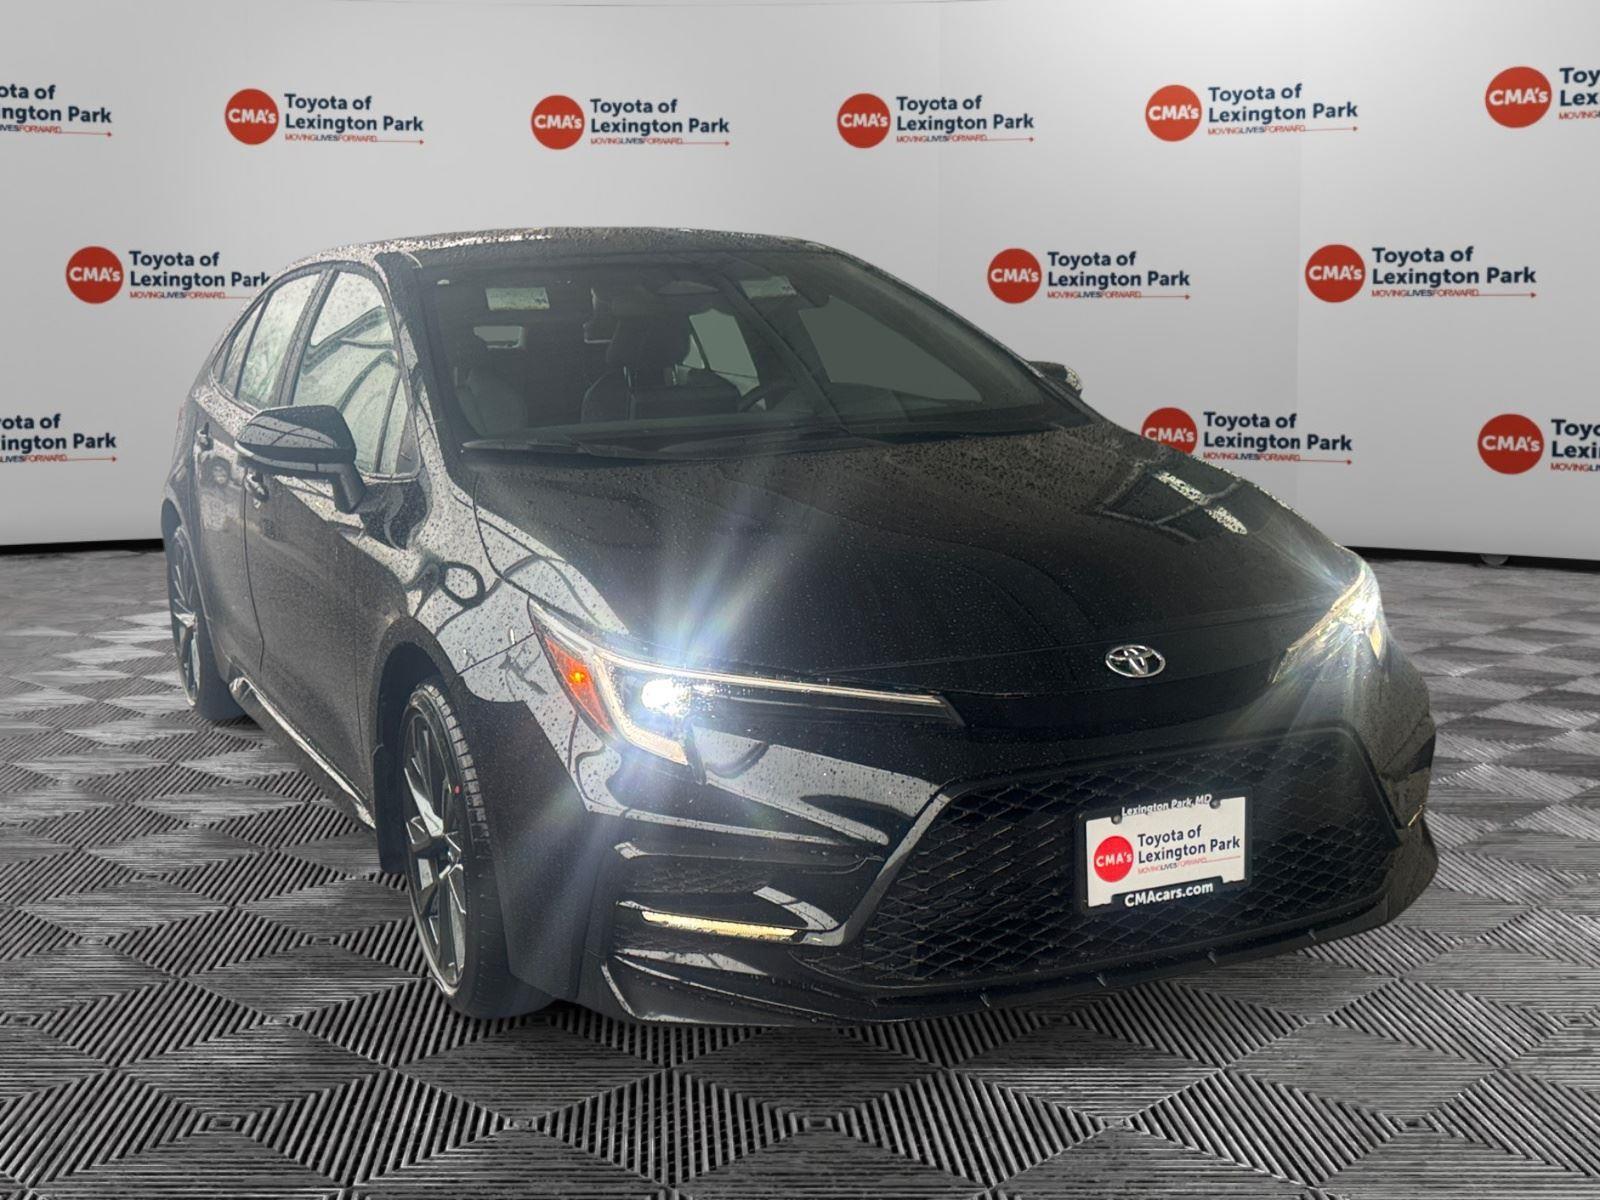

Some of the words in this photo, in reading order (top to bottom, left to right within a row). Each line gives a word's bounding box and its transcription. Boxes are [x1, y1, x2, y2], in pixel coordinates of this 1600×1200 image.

[34, 84, 56, 100] of
[1208, 86, 1275, 106] Toyota
[1281, 83, 1303, 100] of
[1489, 87, 1549, 106] CMA's
[1560, 90, 1599, 107] Lex
[284, 93, 348, 113] Toyota
[353, 95, 372, 110] of
[590, 98, 654, 117] Toyota
[658, 98, 678, 114] of
[896, 96, 958, 115] Toyota
[962, 94, 983, 110] of
[2, 105, 61, 124] ngton
[68, 106, 112, 123] Park
[228, 108, 277, 124] CMA's
[534, 114, 582, 130] CMA's
[840, 113, 888, 128] CMA's
[1148, 105, 1199, 121] CMA's
[1208, 106, 1306, 125] Lexington
[1313, 101, 1358, 119] Park
[285, 113, 377, 133] Lexington
[383, 115, 424, 132] Park
[590, 118, 683, 137] Lexington
[688, 118, 730, 133] Park
[896, 116, 987, 134] Lexington
[993, 113, 1034, 129] Park
[129, 250, 195, 270] Toyota
[200, 251, 220, 267] of
[1047, 251, 1111, 270] Toyota
[1116, 251, 1137, 266] of
[1371, 247, 1445, 267] Toyota
[1450, 246, 1474, 262] of
[69, 267, 121, 282] CMA's
[130, 271, 225, 290] Lexington
[231, 271, 271, 287] Park
[990, 268, 1039, 283] CMA's
[1048, 271, 1142, 290] Lexington
[1148, 270, 1190, 286] Park
[1308, 265, 1363, 281] CMA's
[1372, 268, 1480, 288] Lexington
[1487, 266, 1537, 284] Park
[0, 415, 34, 430] ota
[40, 413, 61, 428] of
[1203, 411, 1270, 431] Toyota
[1275, 413, 1297, 429] of
[1, 435, 67, 454] ington
[73, 432, 117, 449] Park
[1145, 427, 1194, 443] CMA's
[1203, 432, 1301, 453] Lexington
[1307, 433, 1353, 451] Park
[1482, 435, 1540, 452] CMA's
[1552, 441, 1600, 459] Lexi
[1121, 802, 1169, 817] Lexington
[1195, 793, 1213, 806] MD
[1137, 829, 1184, 848] Toyota
[1187, 824, 1202, 839] of
[1138, 843, 1206, 864] Lexington
[1210, 836, 1240, 852] Park
[1095, 853, 1133, 868] CMA's
[1124, 882, 1214, 907] CMAcars.com
